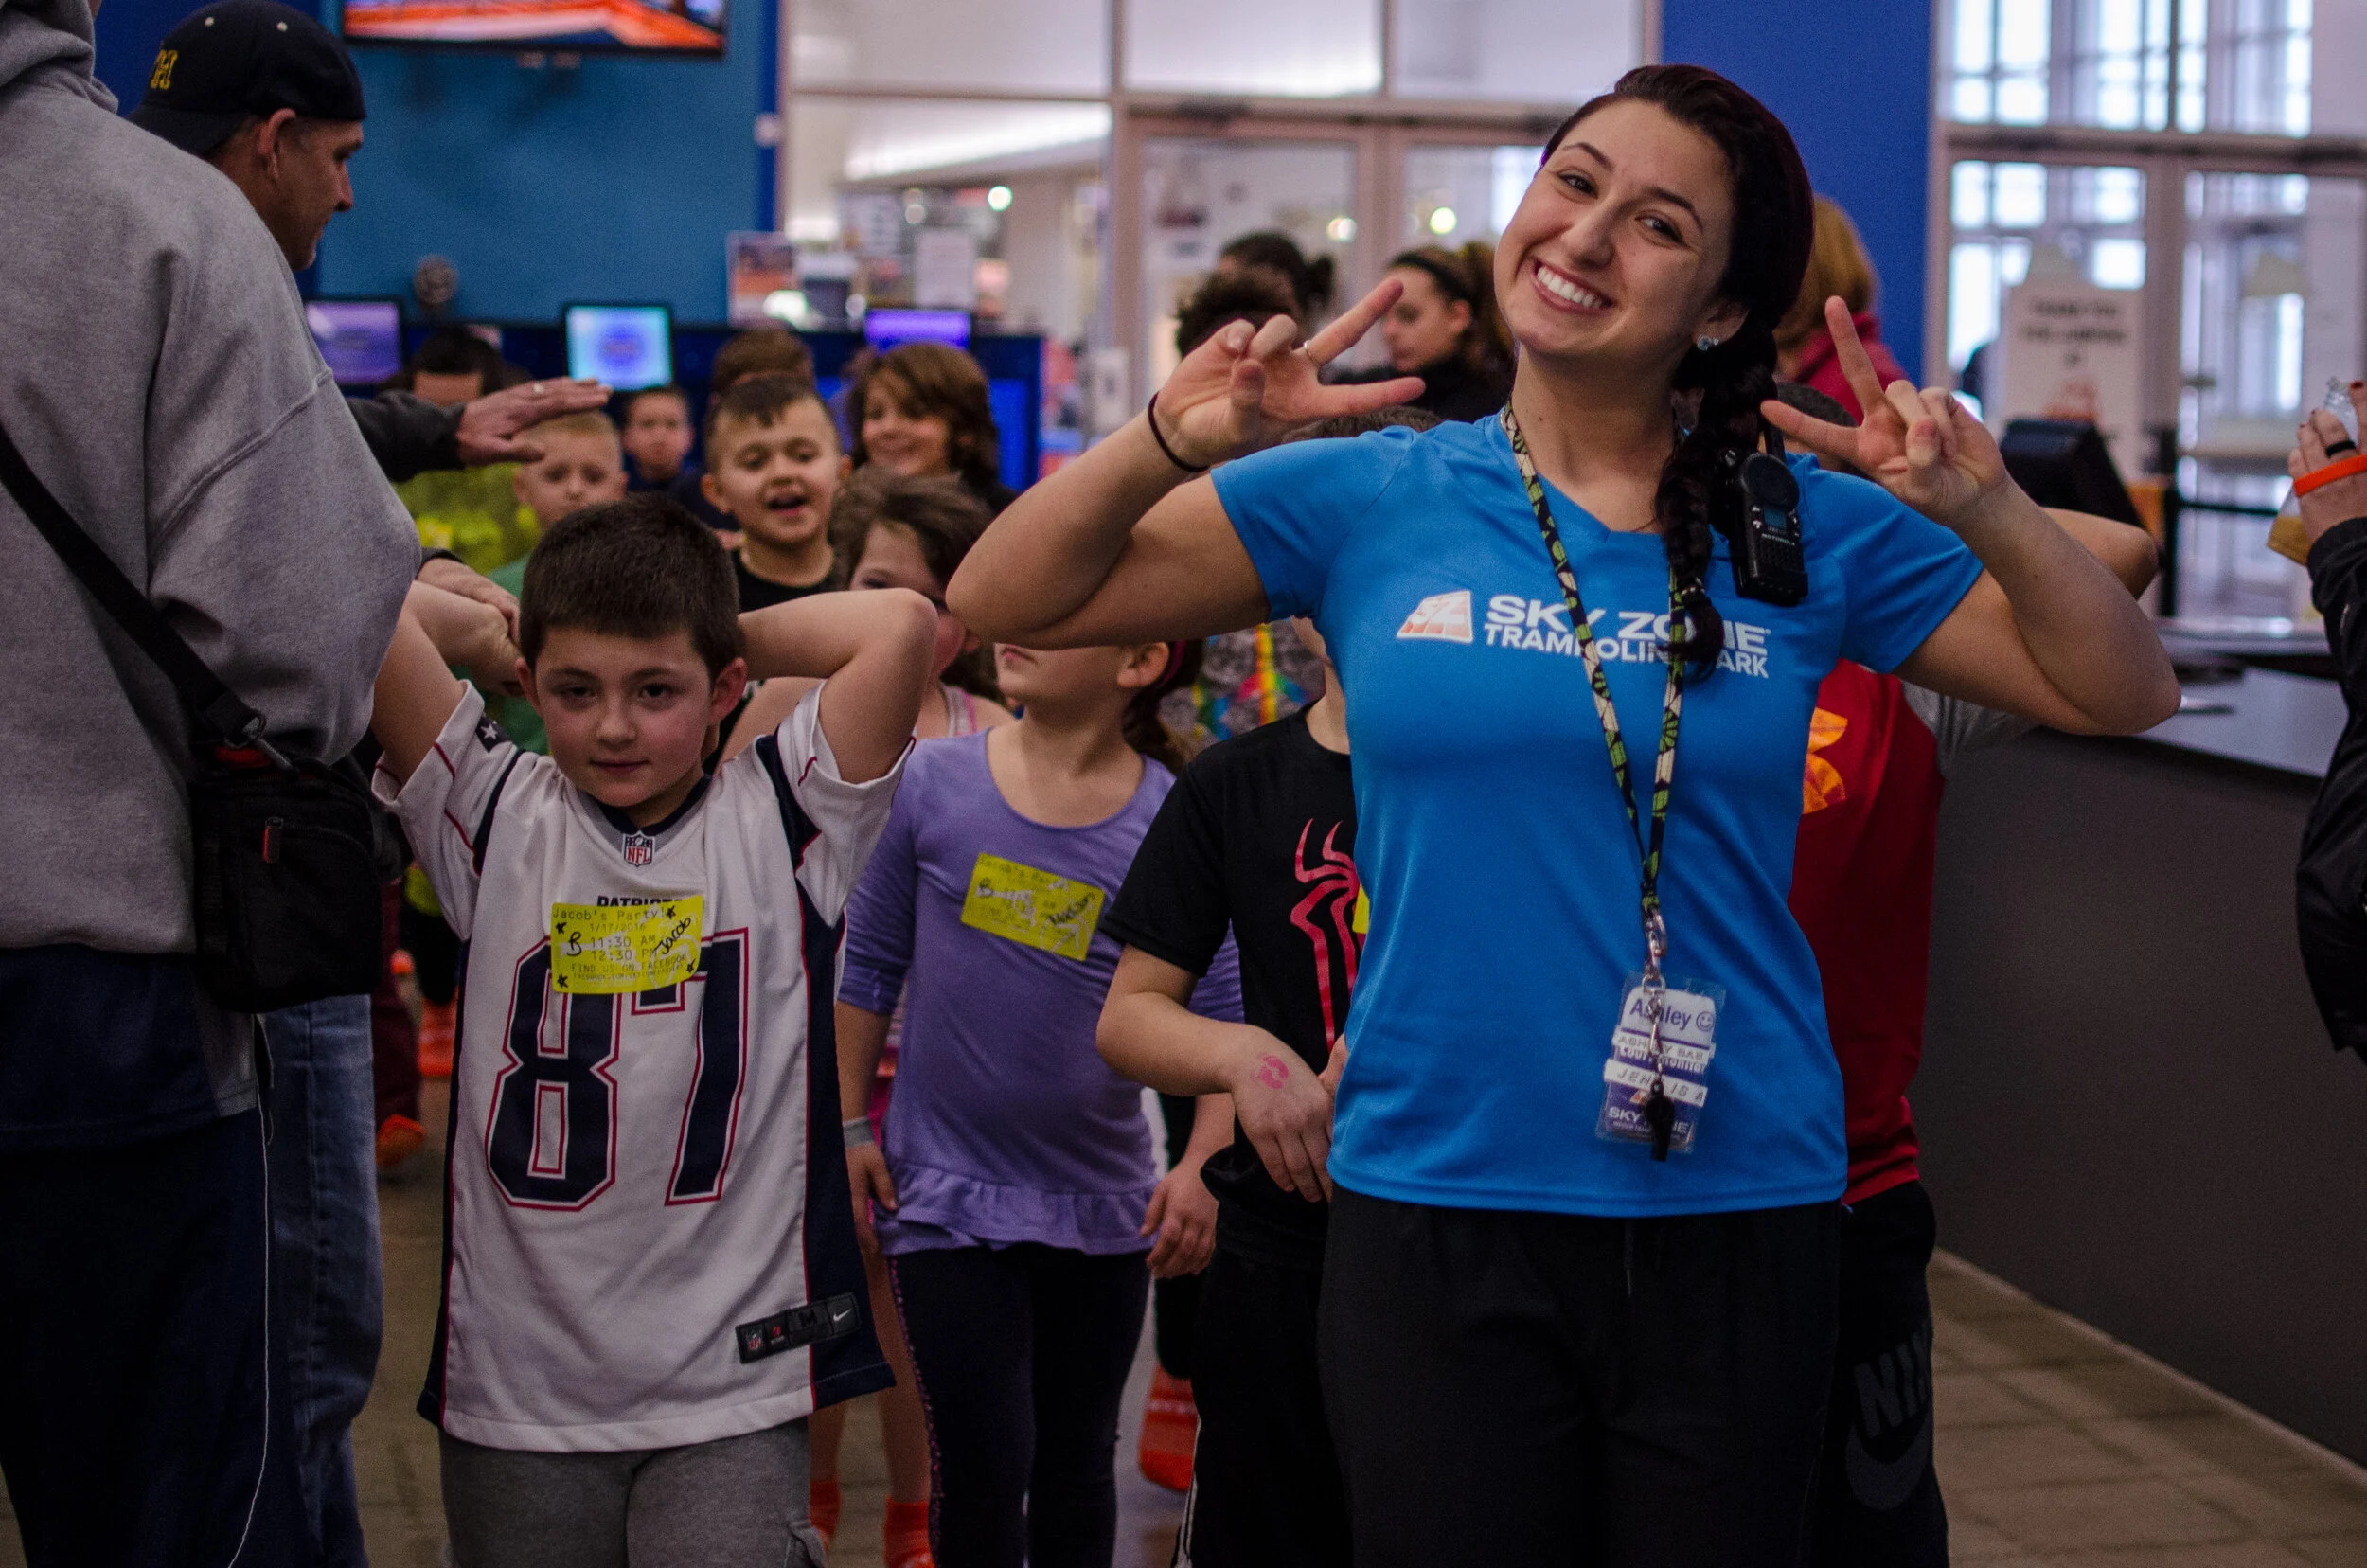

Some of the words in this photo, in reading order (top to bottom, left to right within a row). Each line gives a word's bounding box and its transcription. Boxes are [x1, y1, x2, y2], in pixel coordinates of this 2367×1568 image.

[1484, 622, 1670, 665] TRAMOLIN
[1715, 648, 1769, 679] ARK
[627, 846, 650, 864] NFL
[597, 896, 682, 907] PATR
[552, 908, 608, 921] Jacob's
[617, 906, 665, 921] Party!
[566, 931, 583, 957] B
[591, 935, 632, 948] 11:30
[640, 935, 656, 946] AM
[652, 917, 692, 955] Jacob
[571, 963, 596, 972] FIND
[602, 963, 615, 972] US
[623, 962, 635, 972] ON
[641, 953, 686, 971] FACEBOOK
[591, 949, 632, 962] 12:30
[641, 948, 657, 959] PM
[485, 927, 748, 1212] 87
[1608, 1106, 1641, 1123] SKY
